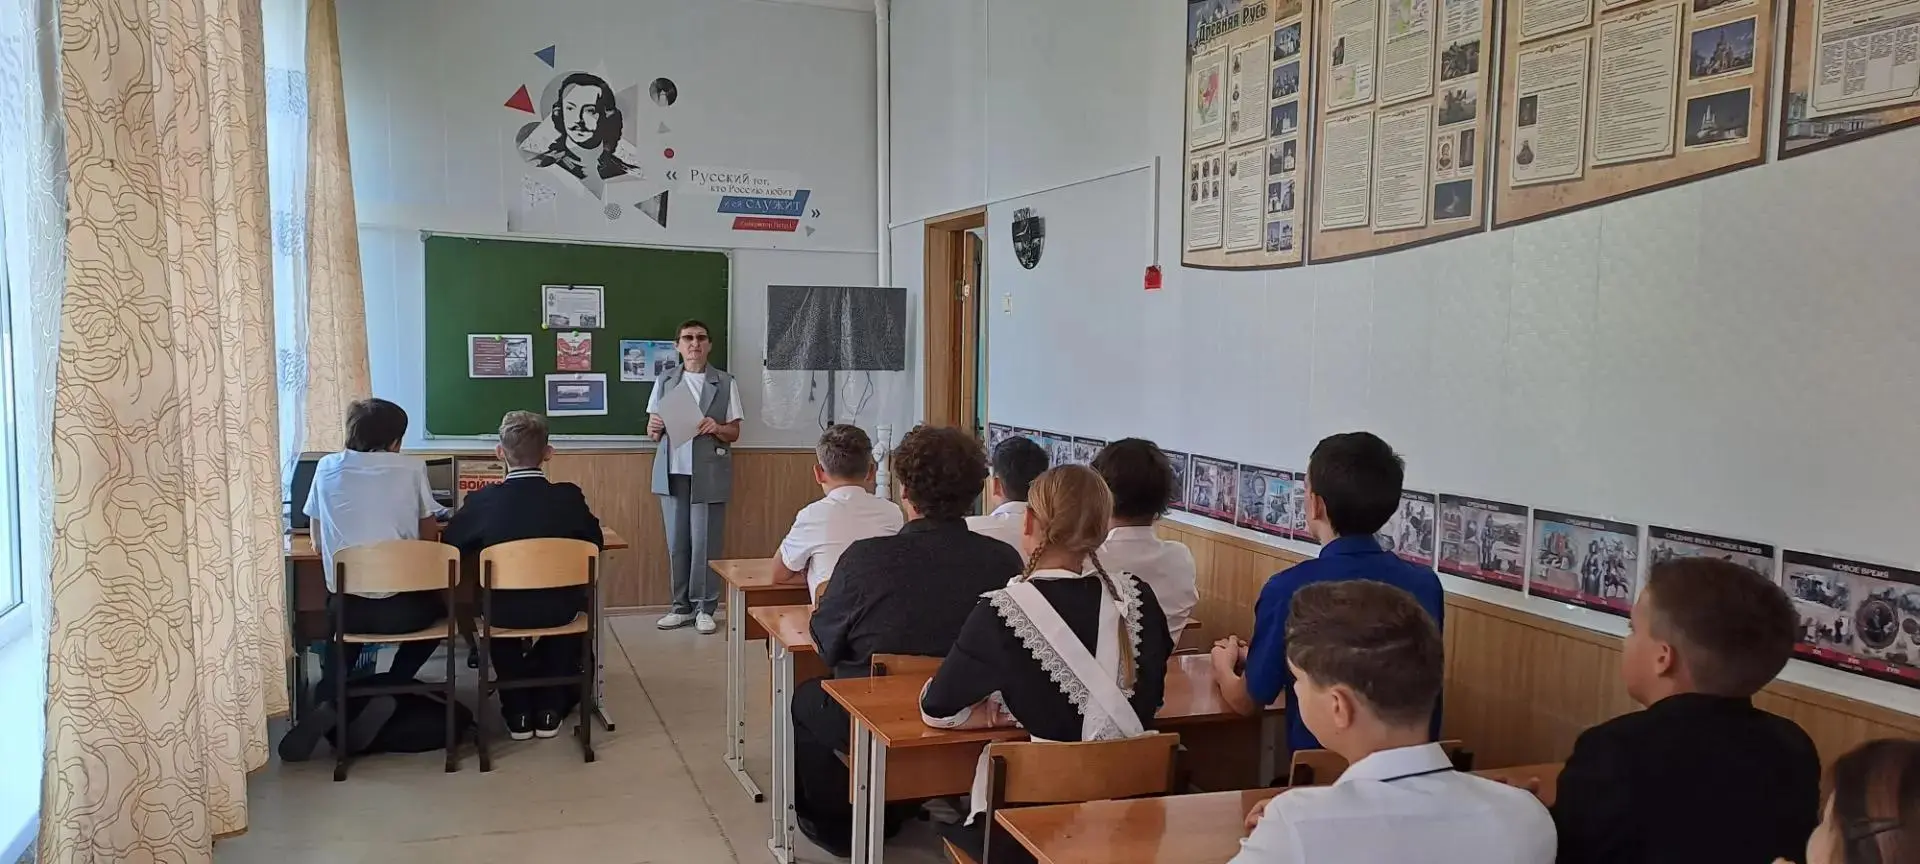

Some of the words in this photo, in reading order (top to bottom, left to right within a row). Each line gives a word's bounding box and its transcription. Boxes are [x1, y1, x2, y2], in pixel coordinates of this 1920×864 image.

[690, 169, 750, 185] Русский
[710, 185, 727, 193] кто
[728, 185, 764, 195] Россию
[765, 187, 792, 197] любит
[1833, 563, 1860, 574] НОВОЕ
[1861, 567, 1889, 578] ВРЕМЯ
